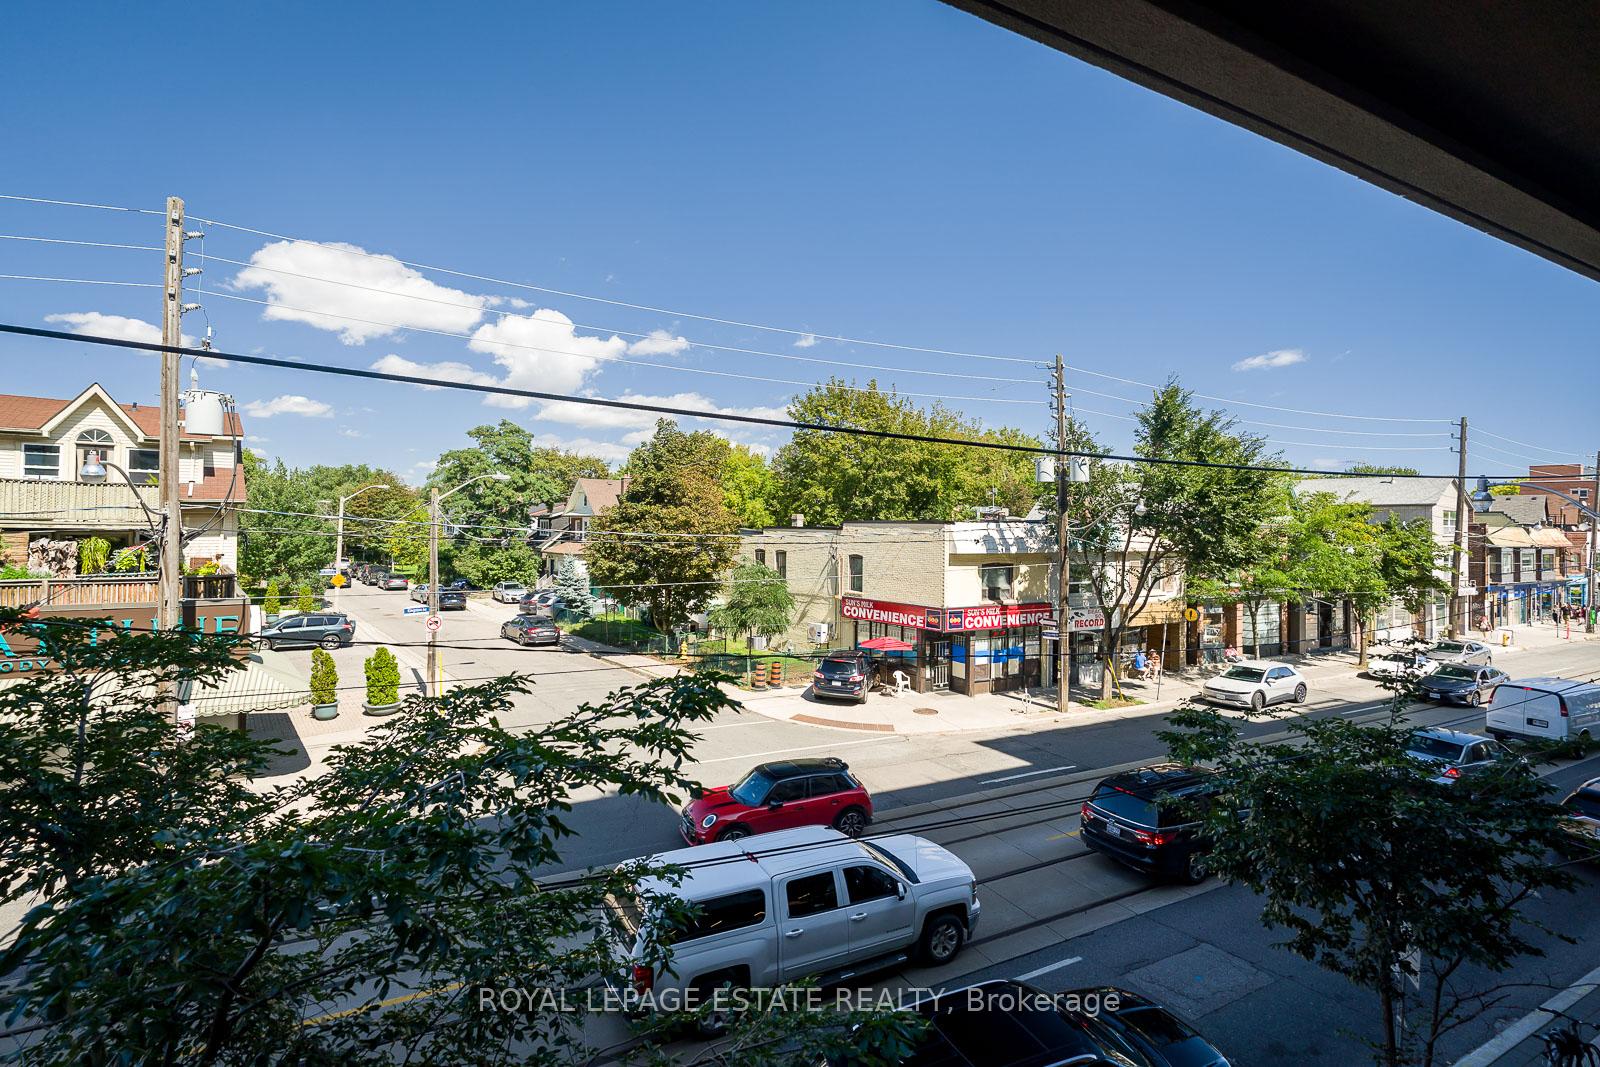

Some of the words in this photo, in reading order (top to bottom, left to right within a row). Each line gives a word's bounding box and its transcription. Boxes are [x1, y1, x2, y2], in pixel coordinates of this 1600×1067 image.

[861, 600, 874, 608] MILK
[986, 607, 1001, 616] MILK
[843, 606, 924, 627] CONVENIENCE
